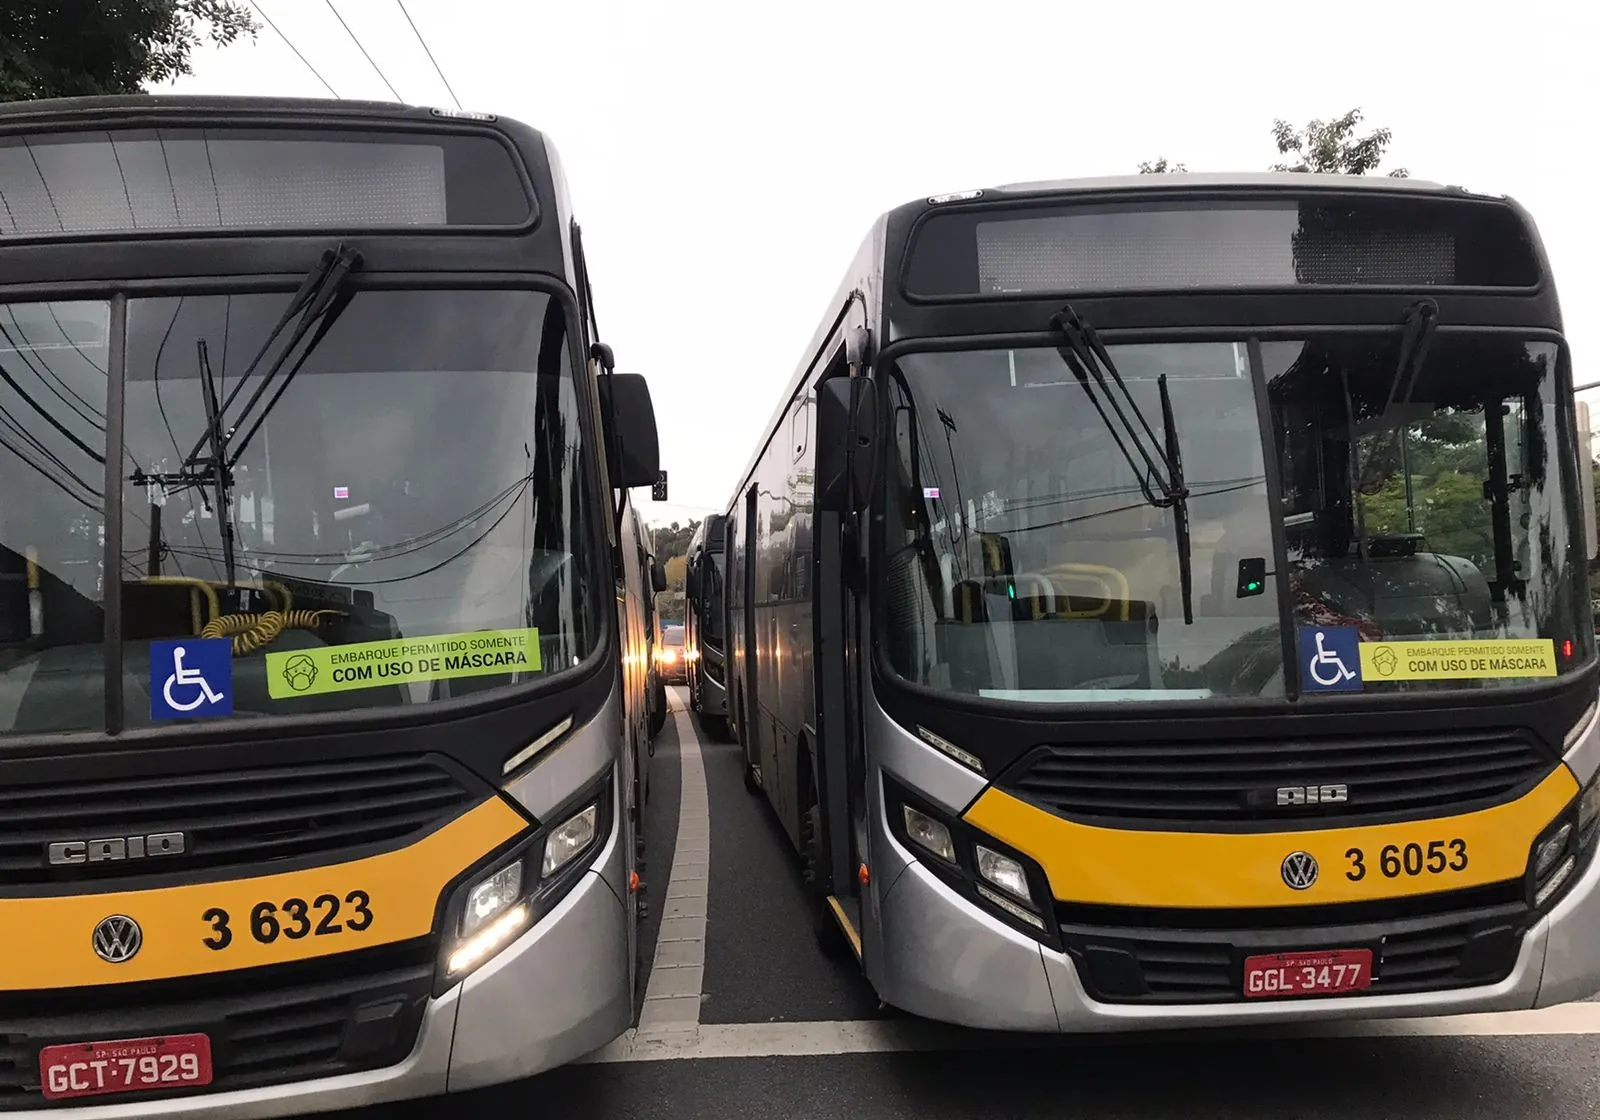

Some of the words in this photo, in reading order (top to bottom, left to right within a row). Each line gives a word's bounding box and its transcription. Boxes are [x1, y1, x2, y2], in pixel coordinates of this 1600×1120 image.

[331, 647, 399, 664] EMBARQUE
[402, 641, 467, 656] PERMITIDO
[470, 636, 525, 650] SOMENTE
[1407, 648, 1456, 657] EMBARQUE
[1458, 646, 1505, 656] PERMITIDO
[1507, 645, 1545, 655] SOMENTE
[1409, 660, 1438, 672] COM
[1441, 659, 1467, 671] USO
[1471, 659, 1486, 671] DE
[1489, 656, 1547, 670] MÁSCARA
[333, 665, 372, 683] COM
[377, 661, 413, 678] USO
[419, 658, 440, 673] DE
[445, 651, 527, 670] MÁSCARA
[49, 832, 185, 865] CAIO
[1345, 847, 1366, 881] 3
[1380, 838, 1468, 878] 6053
[202, 907, 232, 950] 3
[250, 890, 374, 944] 6323
[131, 1047, 157, 1055] PAULO
